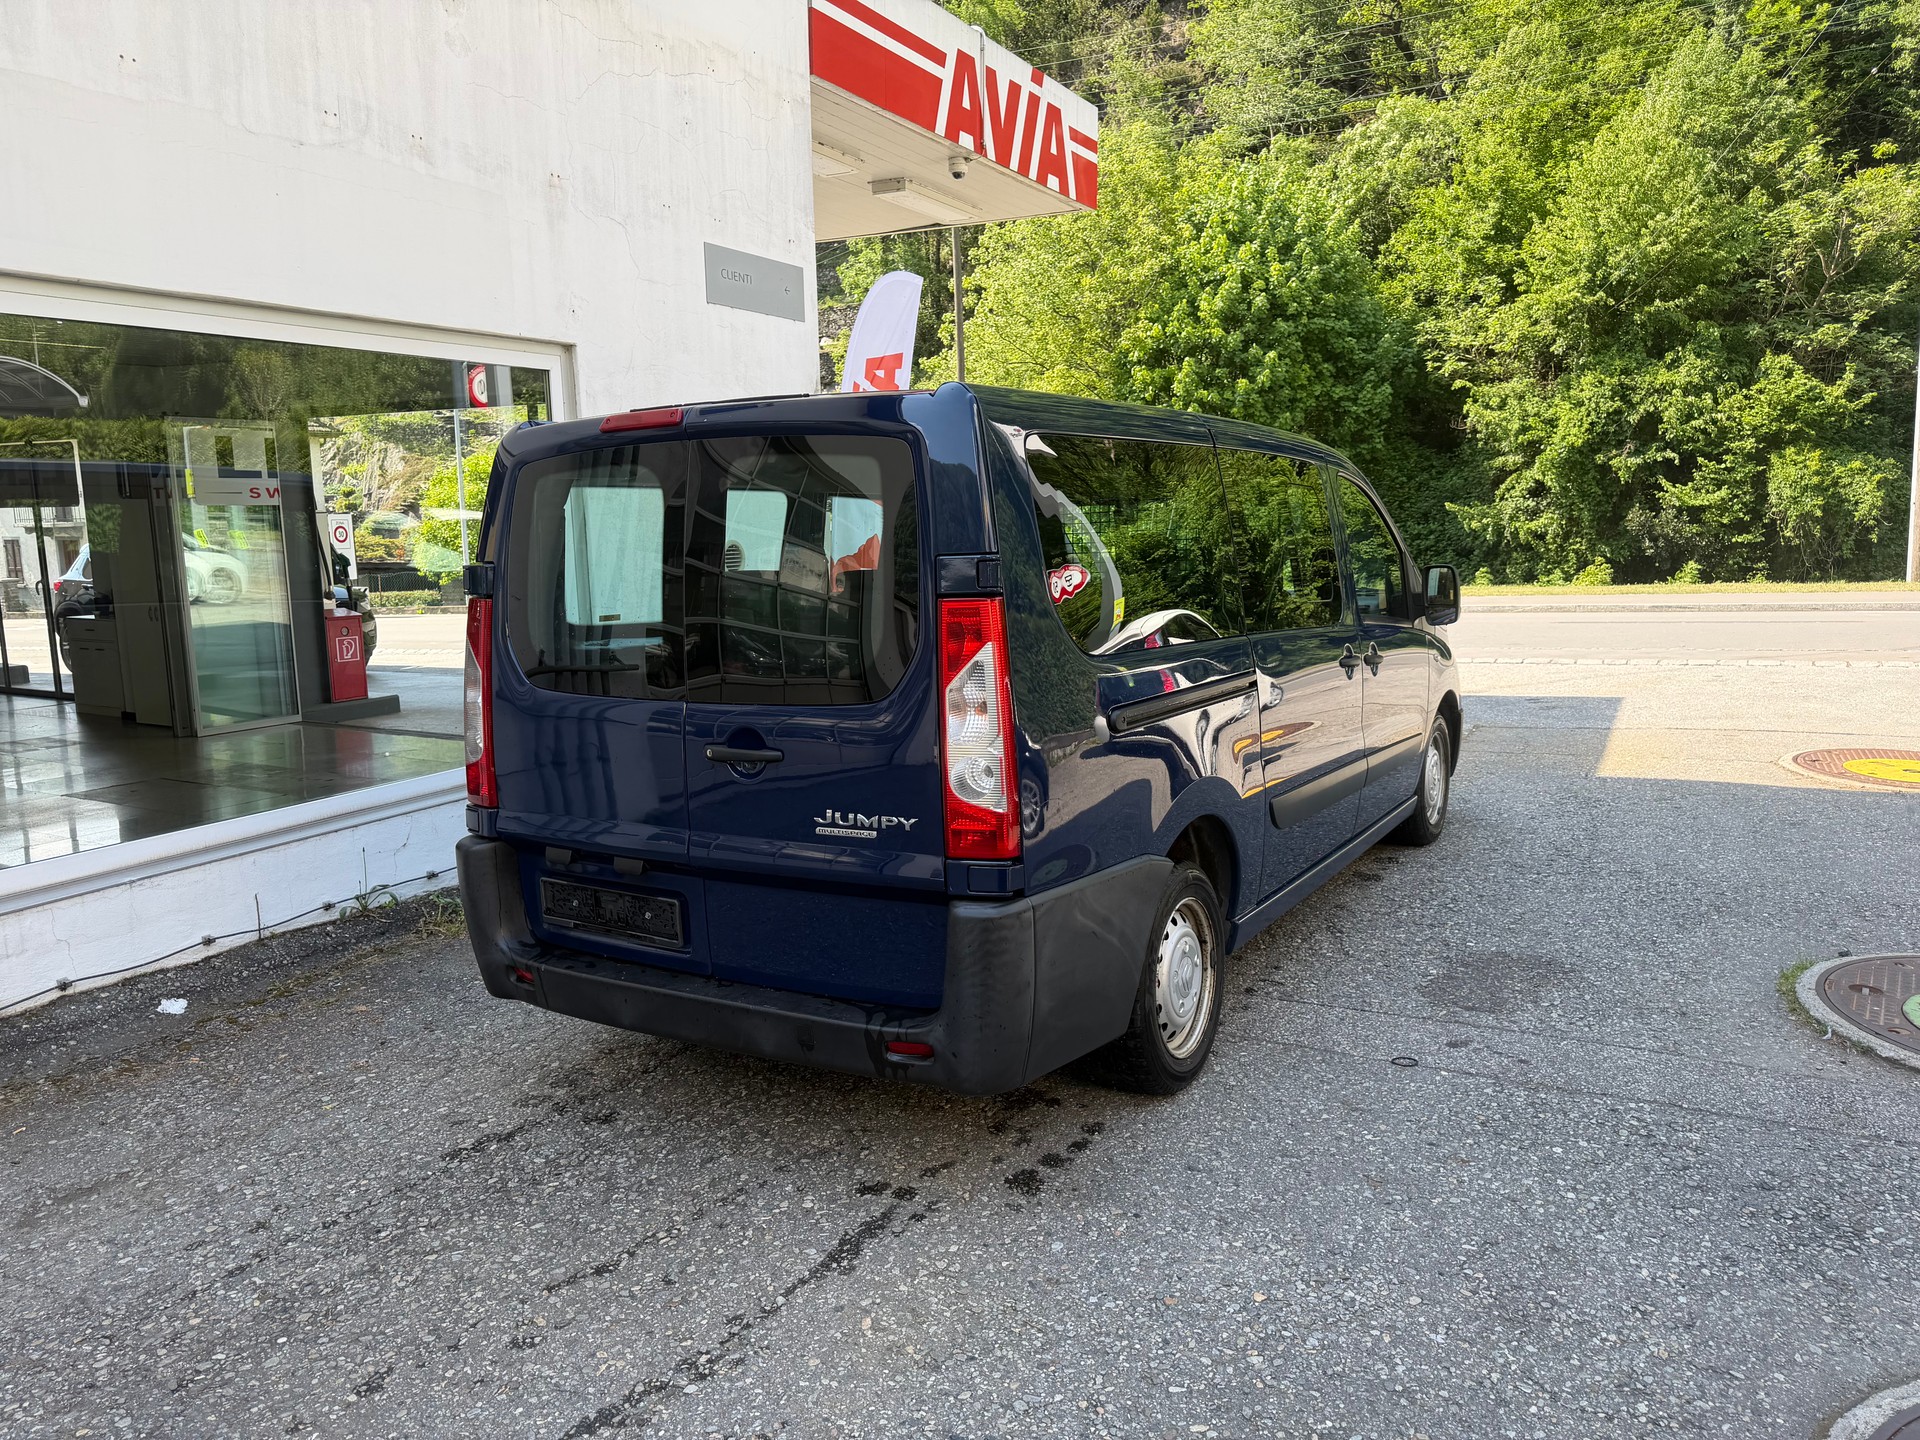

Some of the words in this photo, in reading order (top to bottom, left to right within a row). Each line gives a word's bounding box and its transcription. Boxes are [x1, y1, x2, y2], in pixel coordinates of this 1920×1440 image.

[721, 268, 752, 285] CLIENTI
[814, 809, 918, 831] JUMPY
[817, 827, 876, 838] MULTISPACE
